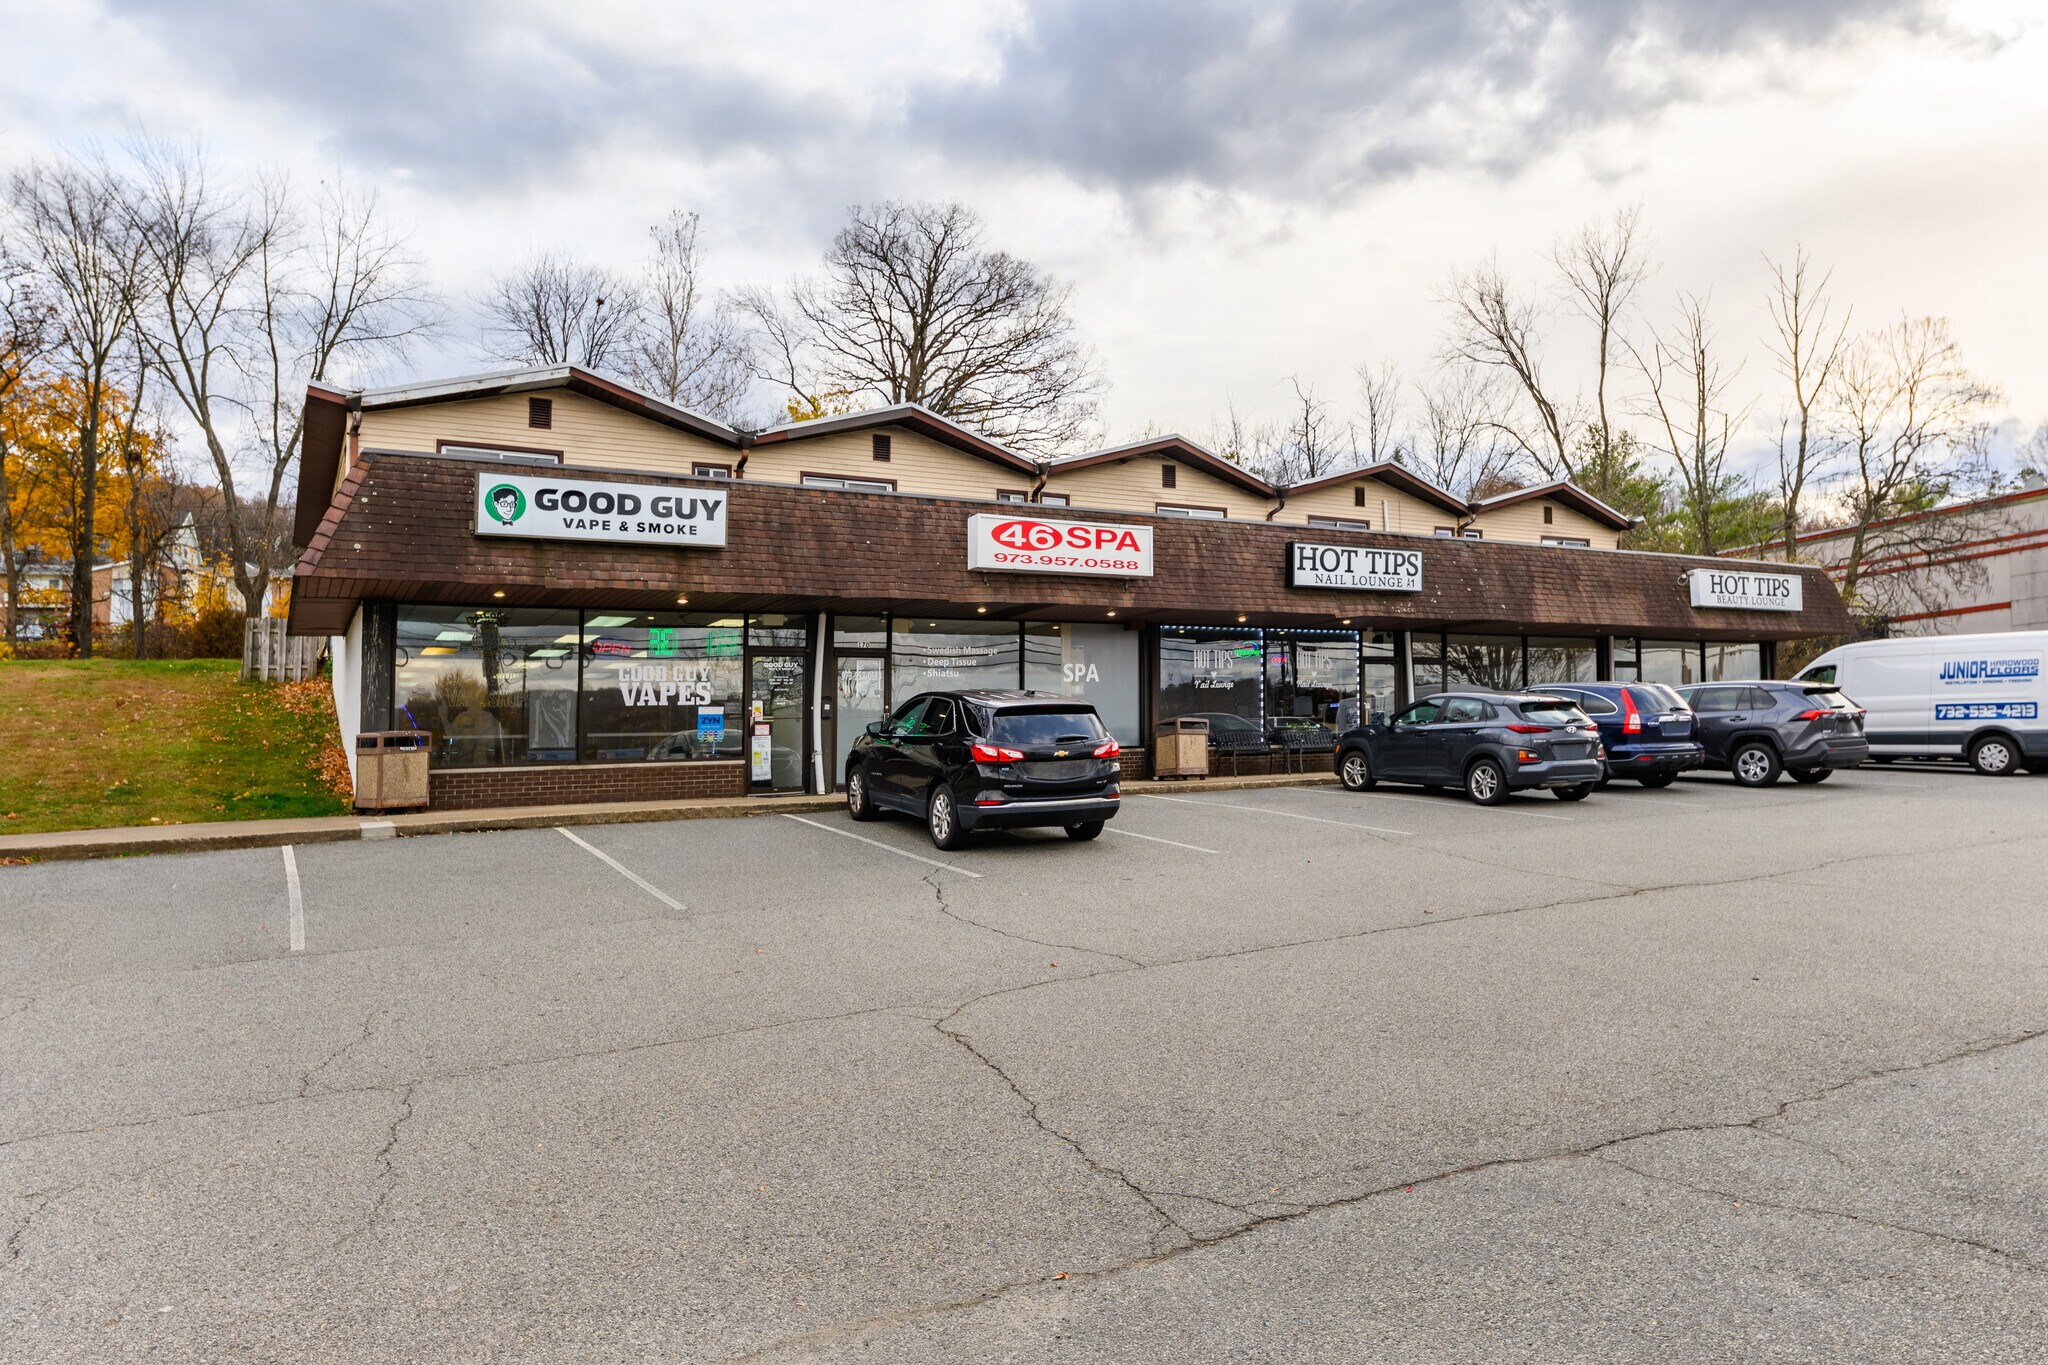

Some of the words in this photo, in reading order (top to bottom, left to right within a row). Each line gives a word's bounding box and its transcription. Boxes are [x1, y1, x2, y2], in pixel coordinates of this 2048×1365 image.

[534, 488, 642, 516] GOOD
[650, 496, 722, 521] GUY
[563, 517, 611, 531] VAPE
[619, 521, 629, 532] &
[637, 522, 697, 536] SMOKE
[999, 524, 1055, 550] 46
[1066, 527, 1141, 552] SPA
[994, 553, 1139, 570] 973.957.0588
[1297, 546, 1358, 573] HOT
[1365, 550, 1419, 577] TIPS
[1315, 574, 1346, 585] NAIL
[1352, 575, 1403, 588] LOUNGE
[1710, 574, 1749, 595] HOT
[1754, 577, 1790, 598] TIPS
[1717, 595, 1749, 605] BEAUTY
[1752, 596, 1785, 607] LOUNGE
[592, 641, 631, 654] OPEN
[927, 646, 961, 654] Swedish
[963, 646, 998, 657] Massage
[927, 658, 949, 668] Deep
[951, 658, 977, 666] Tissue
[1193, 649, 1210, 669] HOT
[1213, 649, 1233, 669] TIPS
[1296, 650, 1313, 669] HOT
[1314, 650, 1332, 669] TIPS
[1990, 659, 2040, 667] HARDWOOD
[618, 665, 667, 682] GOOD
[672, 665, 712, 682] GUY
[927, 669, 960, 678] Shiatsu
[1063, 663, 1100, 683] SPA
[1940, 660, 1988, 680] JUNIOR
[1990, 666, 2039, 675] FLOORS
[1210, 680, 1234, 690] Lounge
[1311, 680, 1333, 691] Lounge
[618, 681, 712, 707] VAPES
[1937, 704, 2036, 719] 732-532-4213
[700, 716, 721, 725] ZYN
